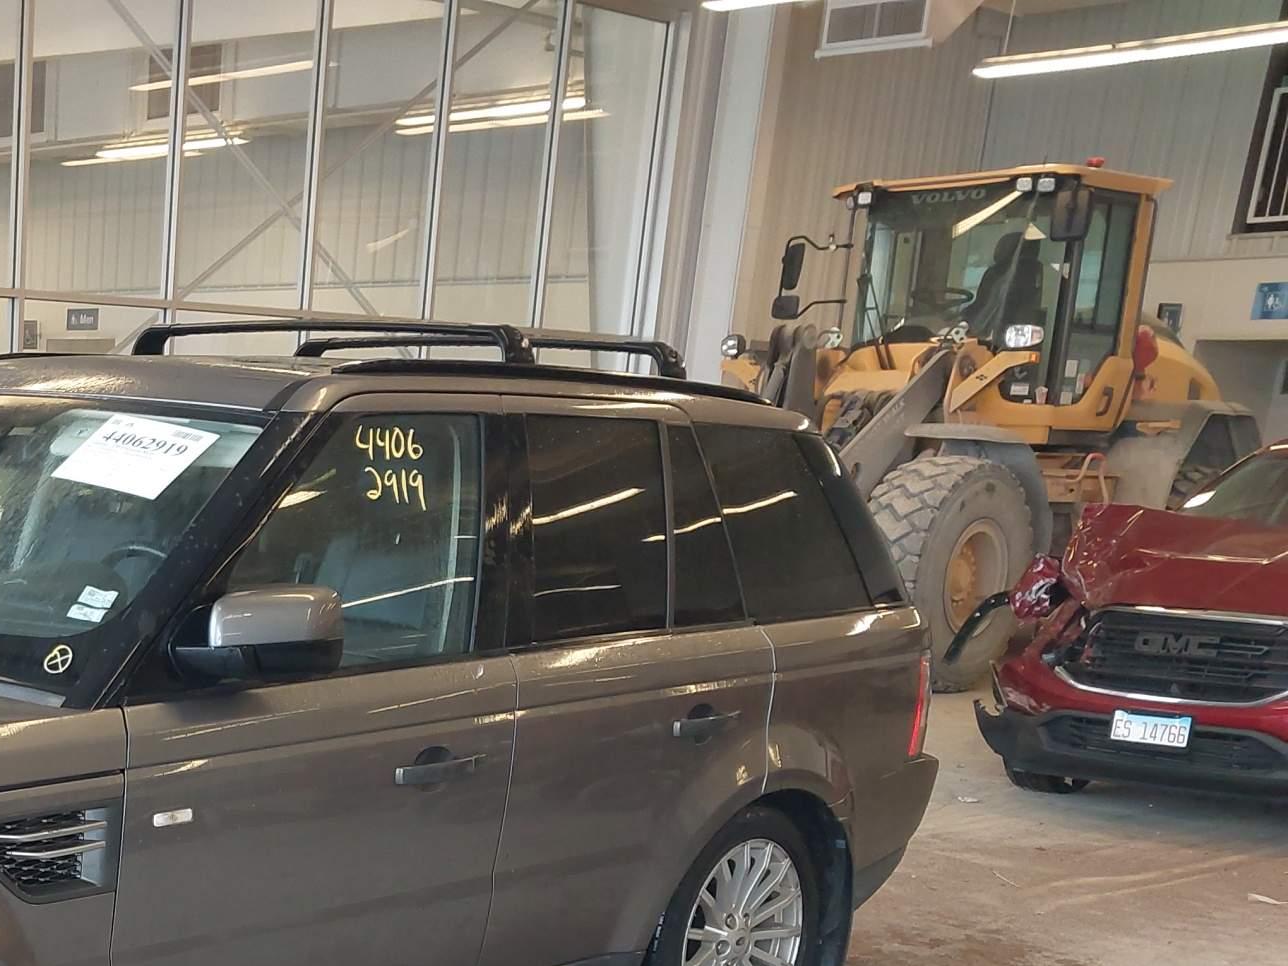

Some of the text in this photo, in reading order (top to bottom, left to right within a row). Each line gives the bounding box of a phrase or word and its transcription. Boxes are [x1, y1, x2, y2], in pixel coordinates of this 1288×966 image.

[911, 188, 986, 204] VOLVO
[103, 430, 189, 457] 44062919
[355, 425, 424, 461] 4406
[364, 466, 427, 511] 2919
[1134, 631, 1220, 657] GMC
[1113, 718, 1187, 744] ES 14766
